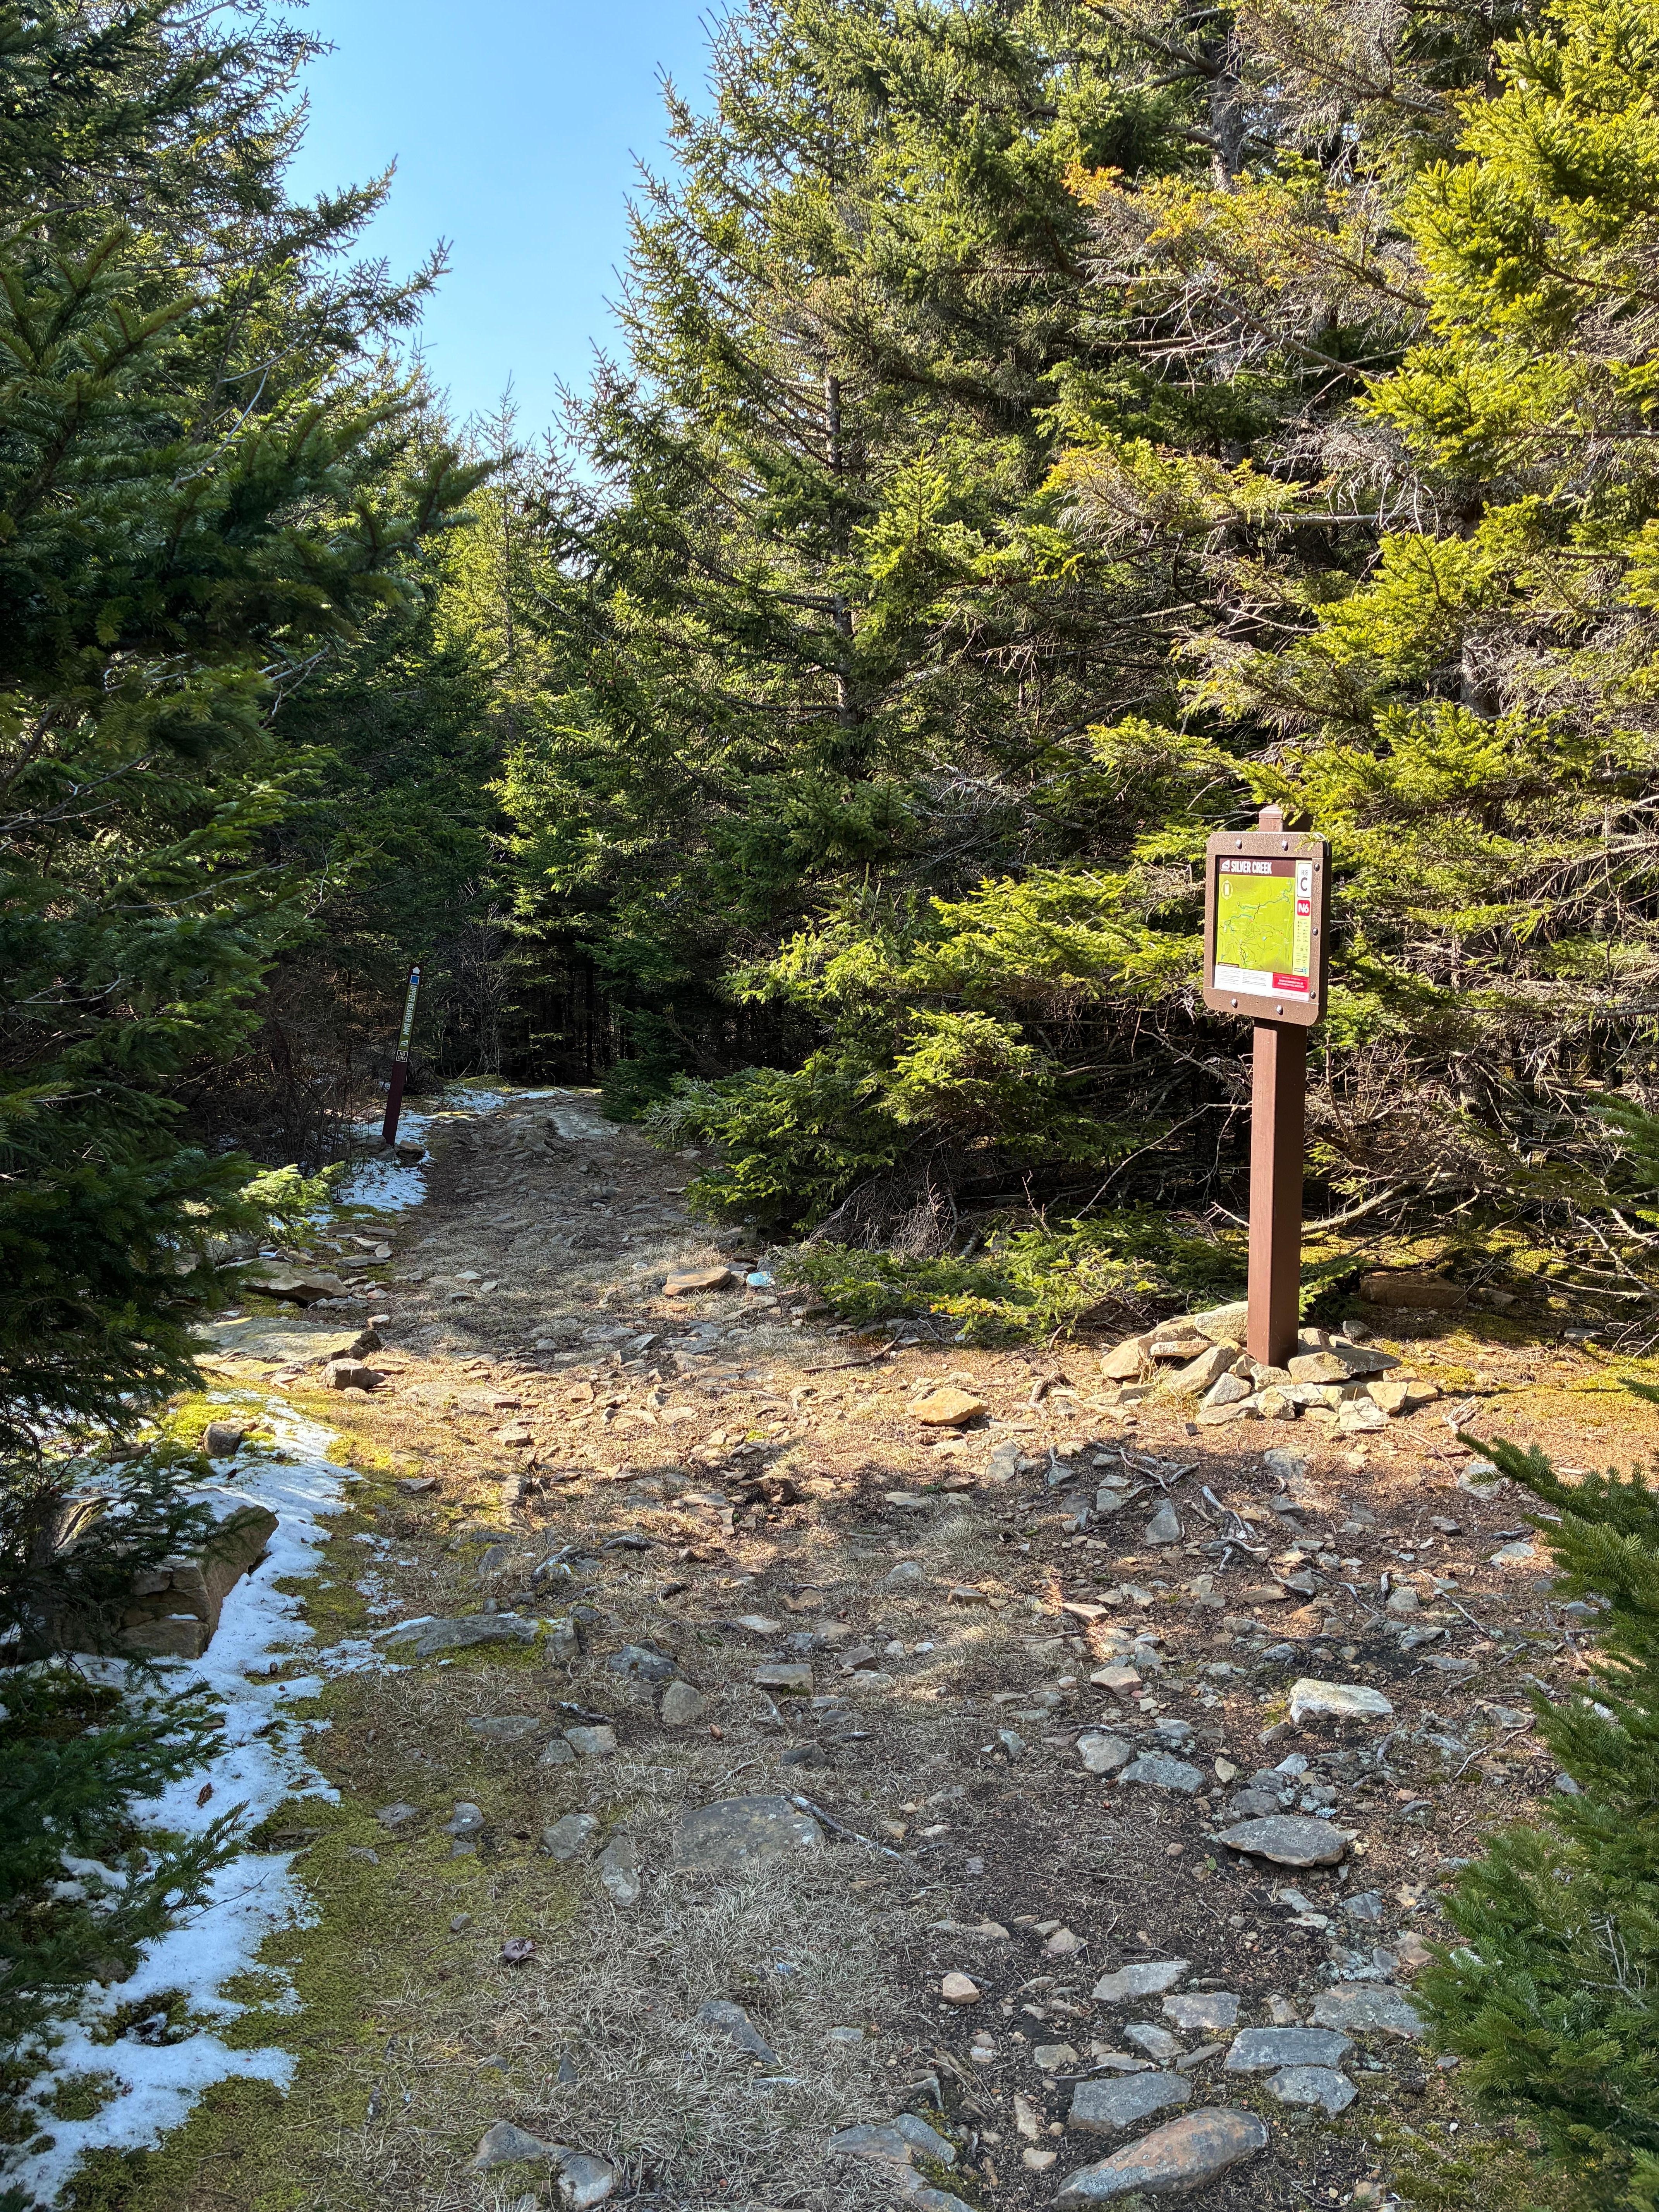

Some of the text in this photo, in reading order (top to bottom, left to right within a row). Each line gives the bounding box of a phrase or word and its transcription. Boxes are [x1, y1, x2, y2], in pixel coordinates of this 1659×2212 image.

[1231, 860, 1272, 874] SILVER CREEK
[1300, 877, 1308, 891] C
[1298, 903, 1309, 914] N6
[403, 985, 417, 1035] UPPER BEAVER DAM
